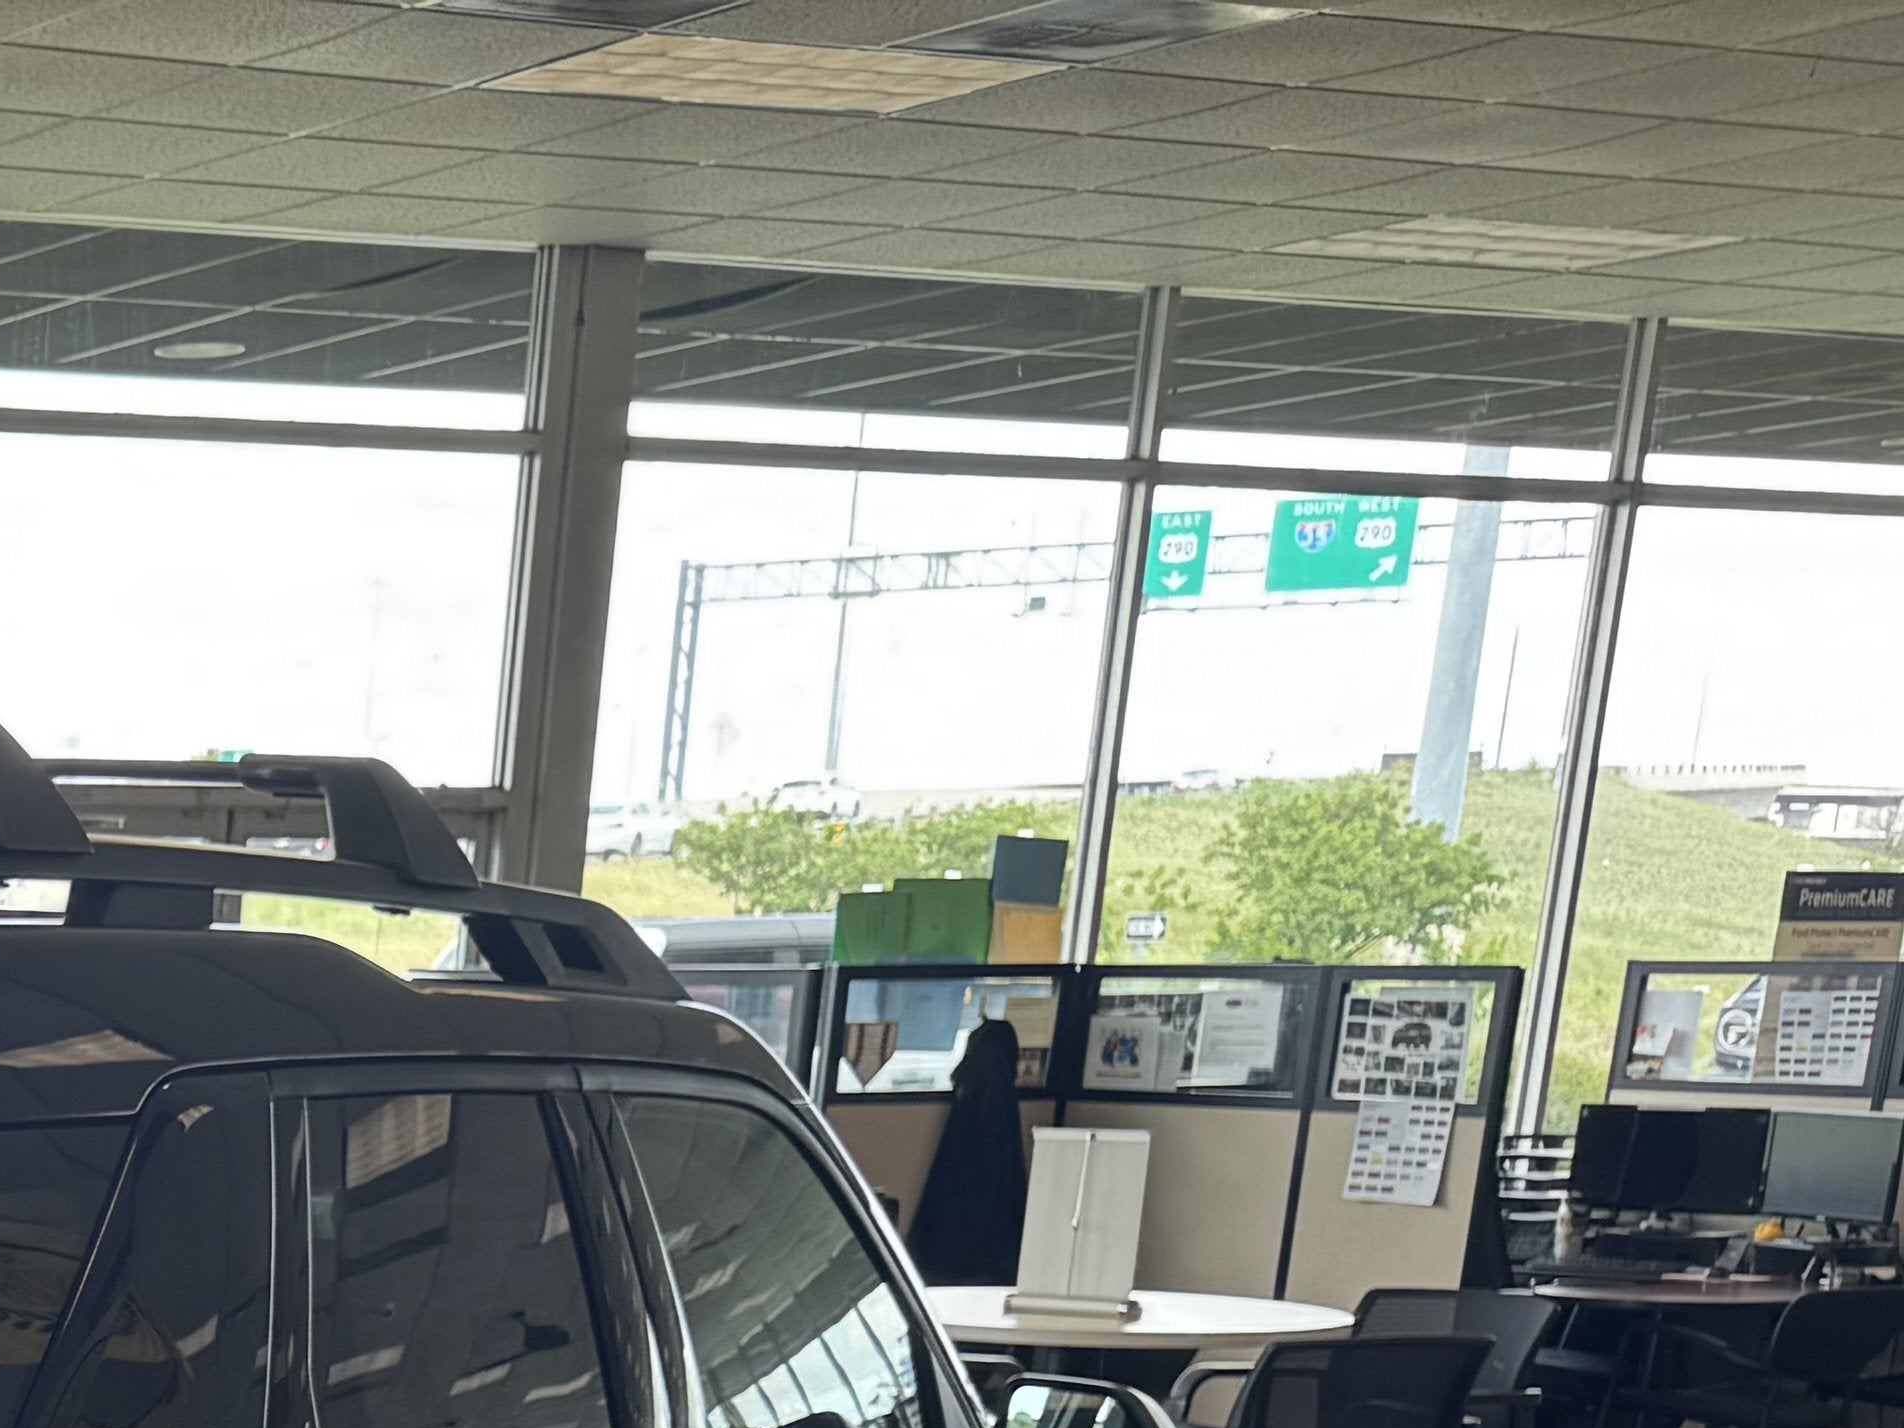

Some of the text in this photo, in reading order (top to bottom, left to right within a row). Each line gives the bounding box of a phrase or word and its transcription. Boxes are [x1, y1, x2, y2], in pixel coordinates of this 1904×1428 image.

[1293, 499, 1400, 516] SOUTH WEST
[1161, 514, 1202, 529] EAST
[1360, 525, 1393, 542] 290
[1163, 538, 1195, 557] 290
[1799, 888, 1895, 908] PremiumCARE
